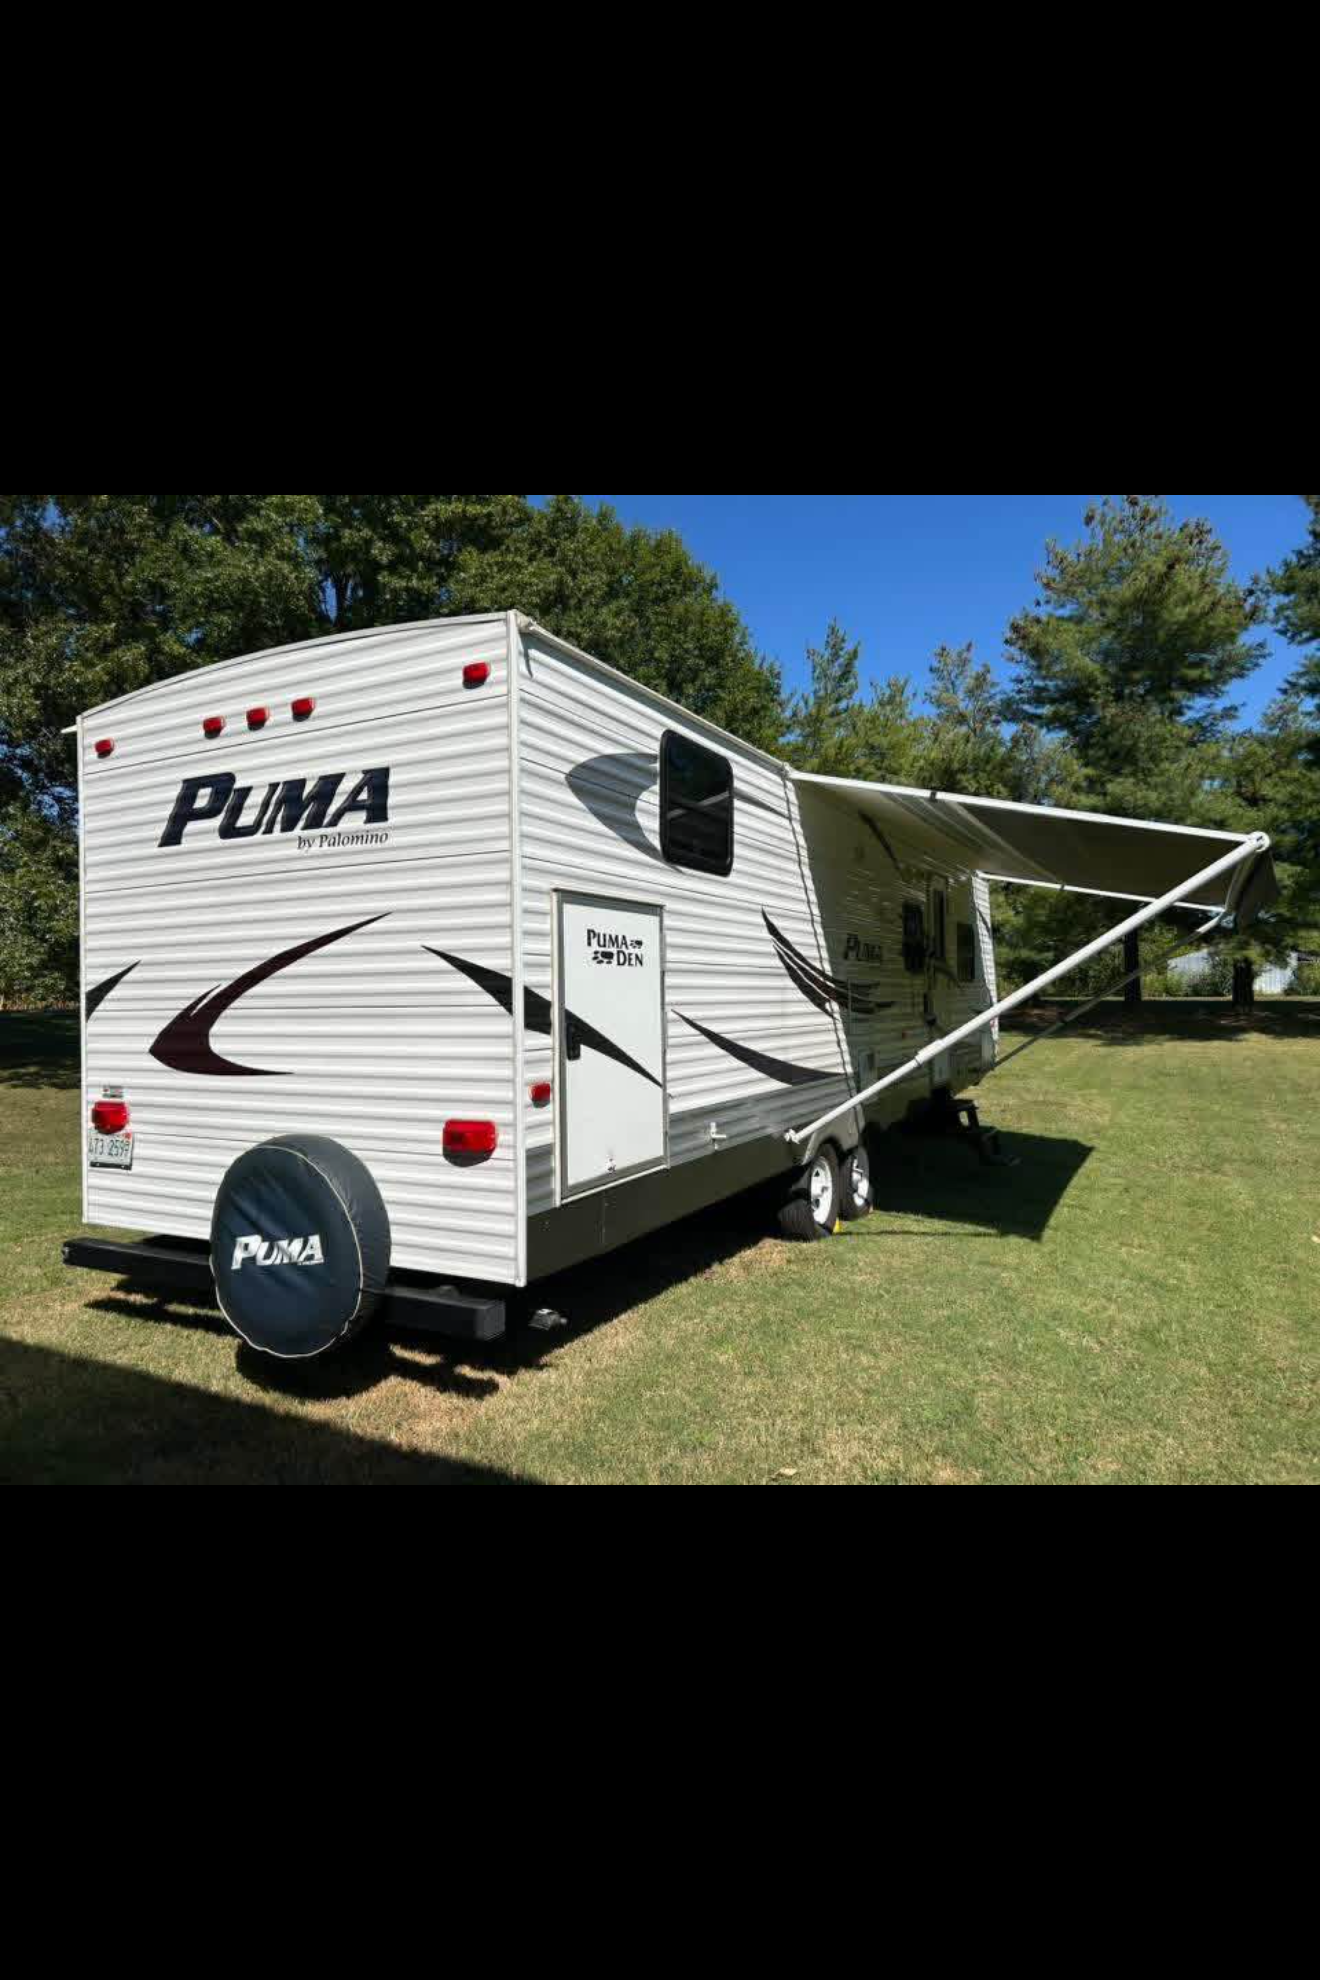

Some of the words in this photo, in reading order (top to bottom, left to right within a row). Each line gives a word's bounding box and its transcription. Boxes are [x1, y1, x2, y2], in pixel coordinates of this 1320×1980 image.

[157, 767, 390, 848] PUMA
[297, 835, 316, 851] by
[319, 831, 389, 848] Palomino
[586, 928, 629, 950] PUMA
[616, 950, 643, 967] DEN
[230, 1234, 325, 1270] PUMA
